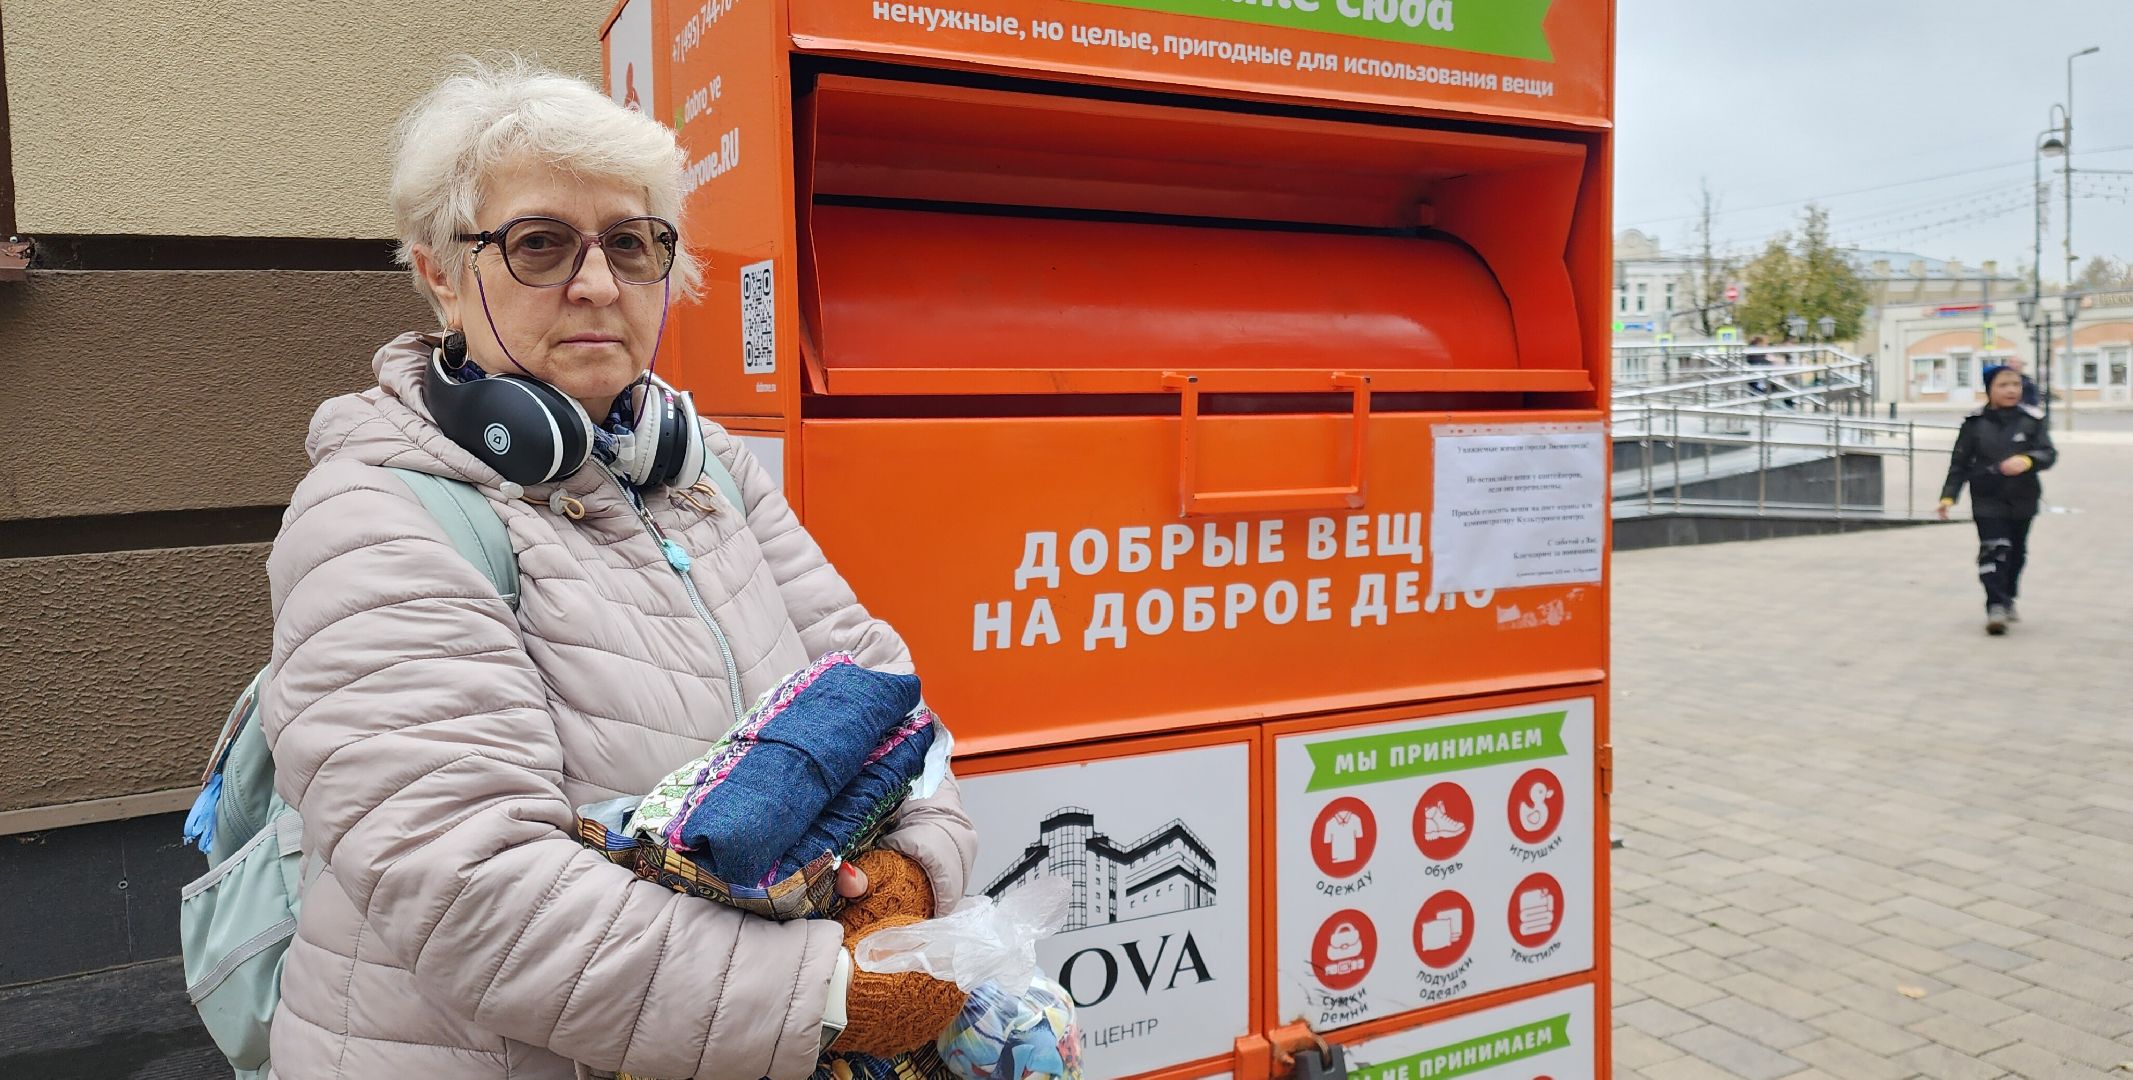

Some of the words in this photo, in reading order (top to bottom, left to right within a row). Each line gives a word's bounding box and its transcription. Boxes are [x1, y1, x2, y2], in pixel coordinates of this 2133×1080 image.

[872, 1, 1026, 40] ненужные,
[1032, 19, 1064, 40] но
[1071, 24, 1159, 55] целые,
[1163, 34, 1293, 66] пригодные
[1297, 50, 1338, 72] для
[1344, 56, 1498, 92] использования
[1502, 74, 1554, 97] вещи
[1014, 520, 1285, 591] ДОБРЫЕ
[1307, 512, 1424, 564] ВЕЩ
[973, 597, 1061, 651] НА
[1084, 578, 1332, 651] ДОБРОЕ
[1334, 750, 1377, 775] МЫ
[1390, 728, 1543, 768] ПРИНИМАЕМ
[1509, 836, 1562, 862] игрушки
[1316, 871, 1374, 897] одежду
[1424, 862, 1464, 880] обувь
[1510, 941, 1562, 964] текстиль
[1059, 930, 1217, 1009] OVA
[1416, 957, 1473, 985] подушки
[1322, 987, 1367, 1010] сумки
[1420, 980, 1467, 1001] одеяла
[1320, 1003, 1368, 1024] ремни
[1094, 1018, 1159, 1048] ЦЕНТР
[1419, 1026, 1552, 1079] ПРИНИМАЕМ
